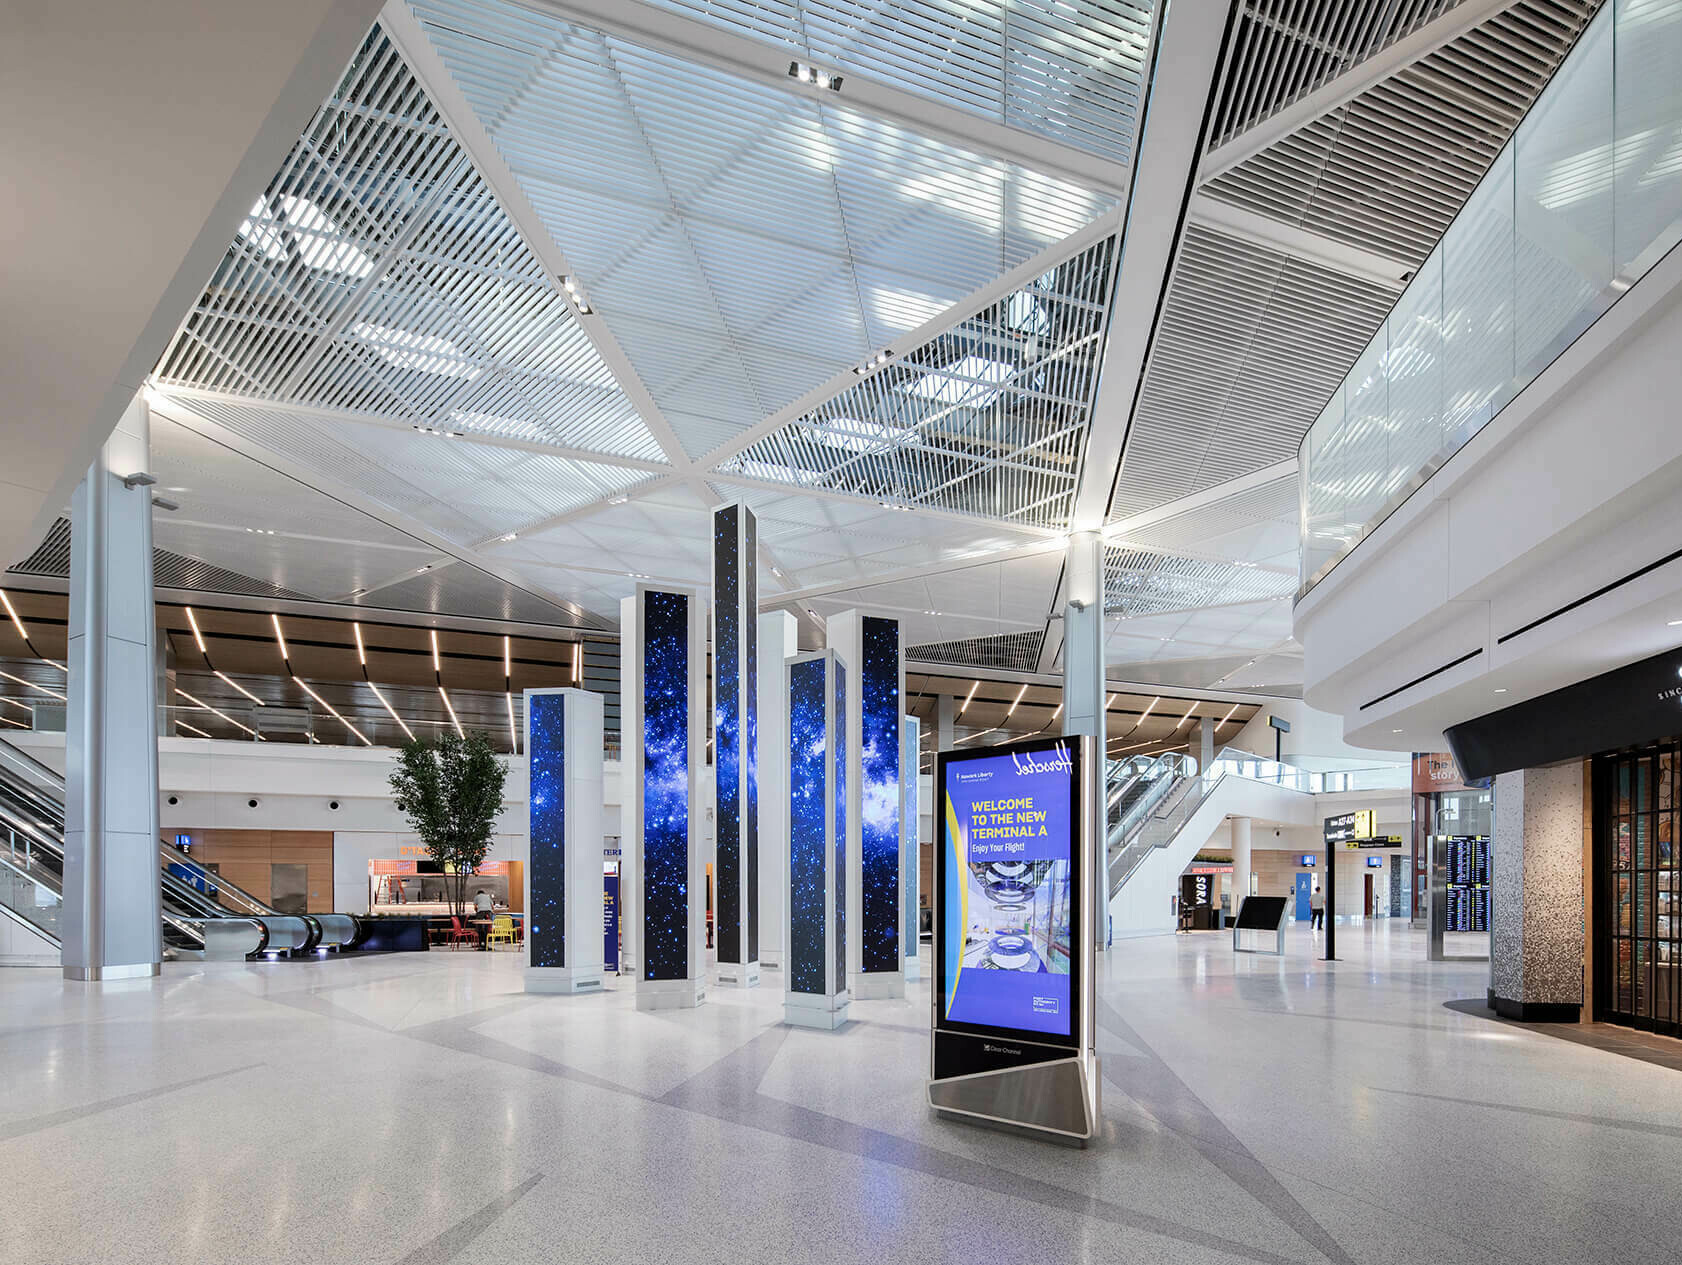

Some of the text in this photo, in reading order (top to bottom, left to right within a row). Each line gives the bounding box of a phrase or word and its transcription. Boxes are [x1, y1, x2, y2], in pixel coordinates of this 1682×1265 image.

[1427, 759, 1448, 769] The
[1431, 771, 1459, 781] story
[972, 797, 1033, 812] WELCOME
[972, 810, 1047, 826] TO THE NEW
[972, 825, 1048, 839] TERMINAL A
[972, 842, 1025, 854] Enjoy Your Flight!
[1196, 876, 1207, 905] SORA
